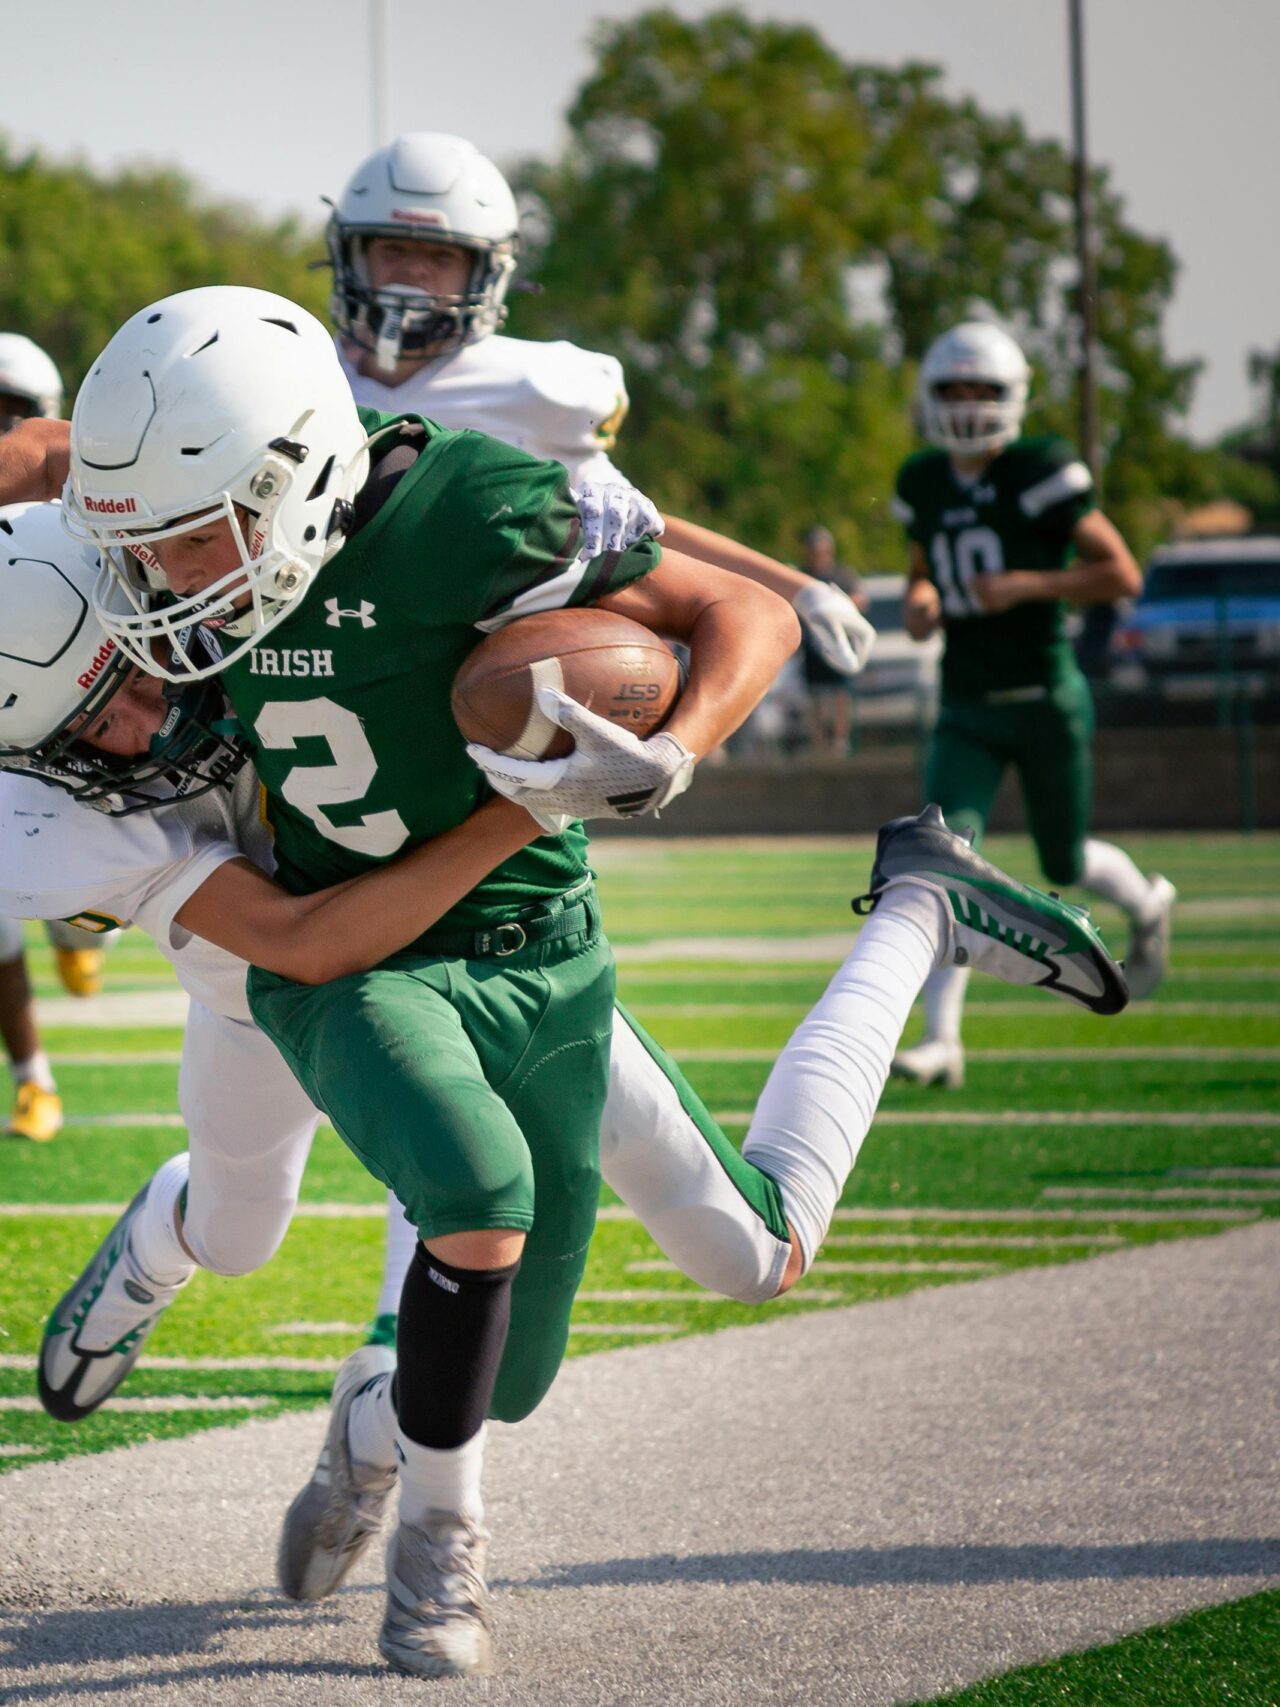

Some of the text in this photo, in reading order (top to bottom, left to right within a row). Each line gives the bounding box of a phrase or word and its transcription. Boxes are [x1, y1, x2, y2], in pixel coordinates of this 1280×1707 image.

[83, 495, 137, 514] Riddell
[931, 526, 1005, 616] 10
[77, 638, 117, 690] Ridde
[250, 648, 335, 676] IRISH
[612, 683, 661, 702] GST
[253, 696, 411, 858] 2
